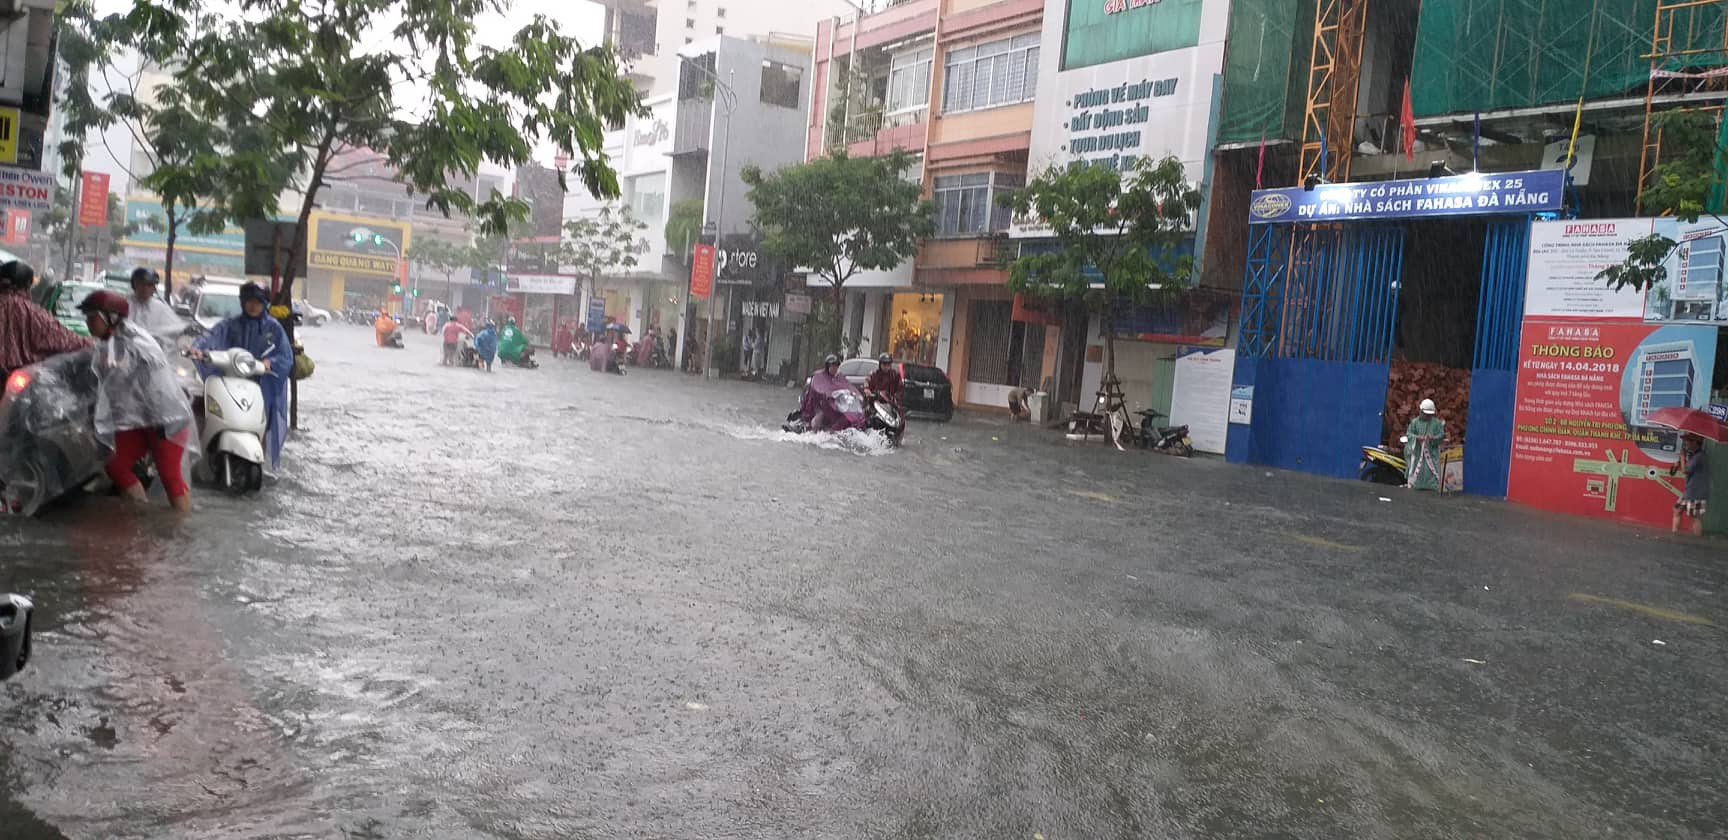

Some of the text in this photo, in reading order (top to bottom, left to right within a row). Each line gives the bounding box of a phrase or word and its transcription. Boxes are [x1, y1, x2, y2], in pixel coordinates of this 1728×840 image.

[1074, 78, 1178, 109] PHÒNG VÉ MÁY BAY
[1124, 103, 1149, 125] SẢN
[1070, 131, 1141, 153] TOUR DU LỊCH
[22, 173, 52, 185] Owen
[1370, 187, 1386, 197] CỔ
[1504, 178, 1523, 190] 25
[1298, 188, 1549, 218] DỰ ÁN: NHÀ SÁCH FAHASA ĐÀ NẴNG
[1565, 223, 1616, 234] FAHASA
[1532, 344, 1614, 359] THÔNG BÁO
[1560, 361, 1620, 373] 14.04.2018
